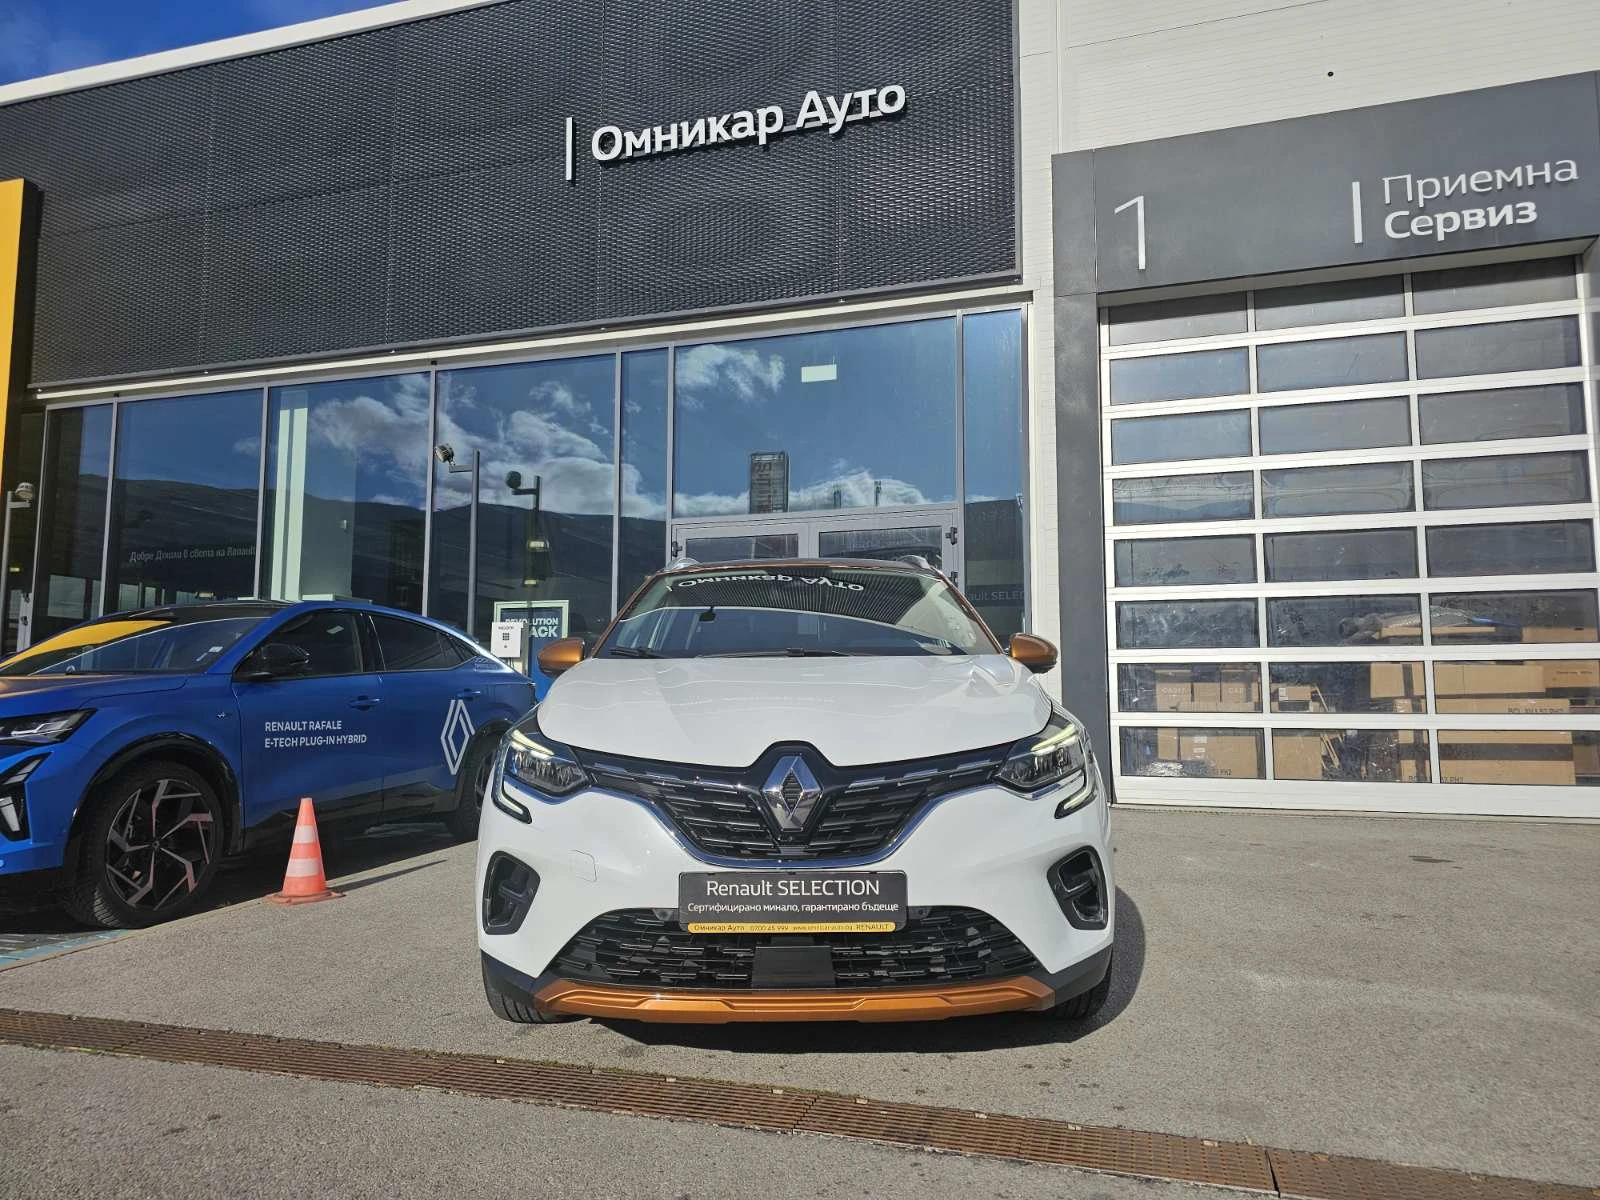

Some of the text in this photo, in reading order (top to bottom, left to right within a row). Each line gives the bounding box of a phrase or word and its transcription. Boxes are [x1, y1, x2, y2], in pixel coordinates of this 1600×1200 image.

[591, 84, 906, 162] Омникар Ауто
[1382, 159, 1578, 208] Приемна
[1384, 199, 1537, 241] Сервиз
[1114, 195, 1146, 270] 1
[530, 626, 557, 638] ACK
[264, 720, 342, 732] RENAULT RAFALE
[264, 734, 368, 748] E-TECH PLUG-IN HYBRID
[706, 880, 880, 896] Renault SELECTION
[687, 901, 899, 914] Сертифицирано минало, гарантирано бъдеще
